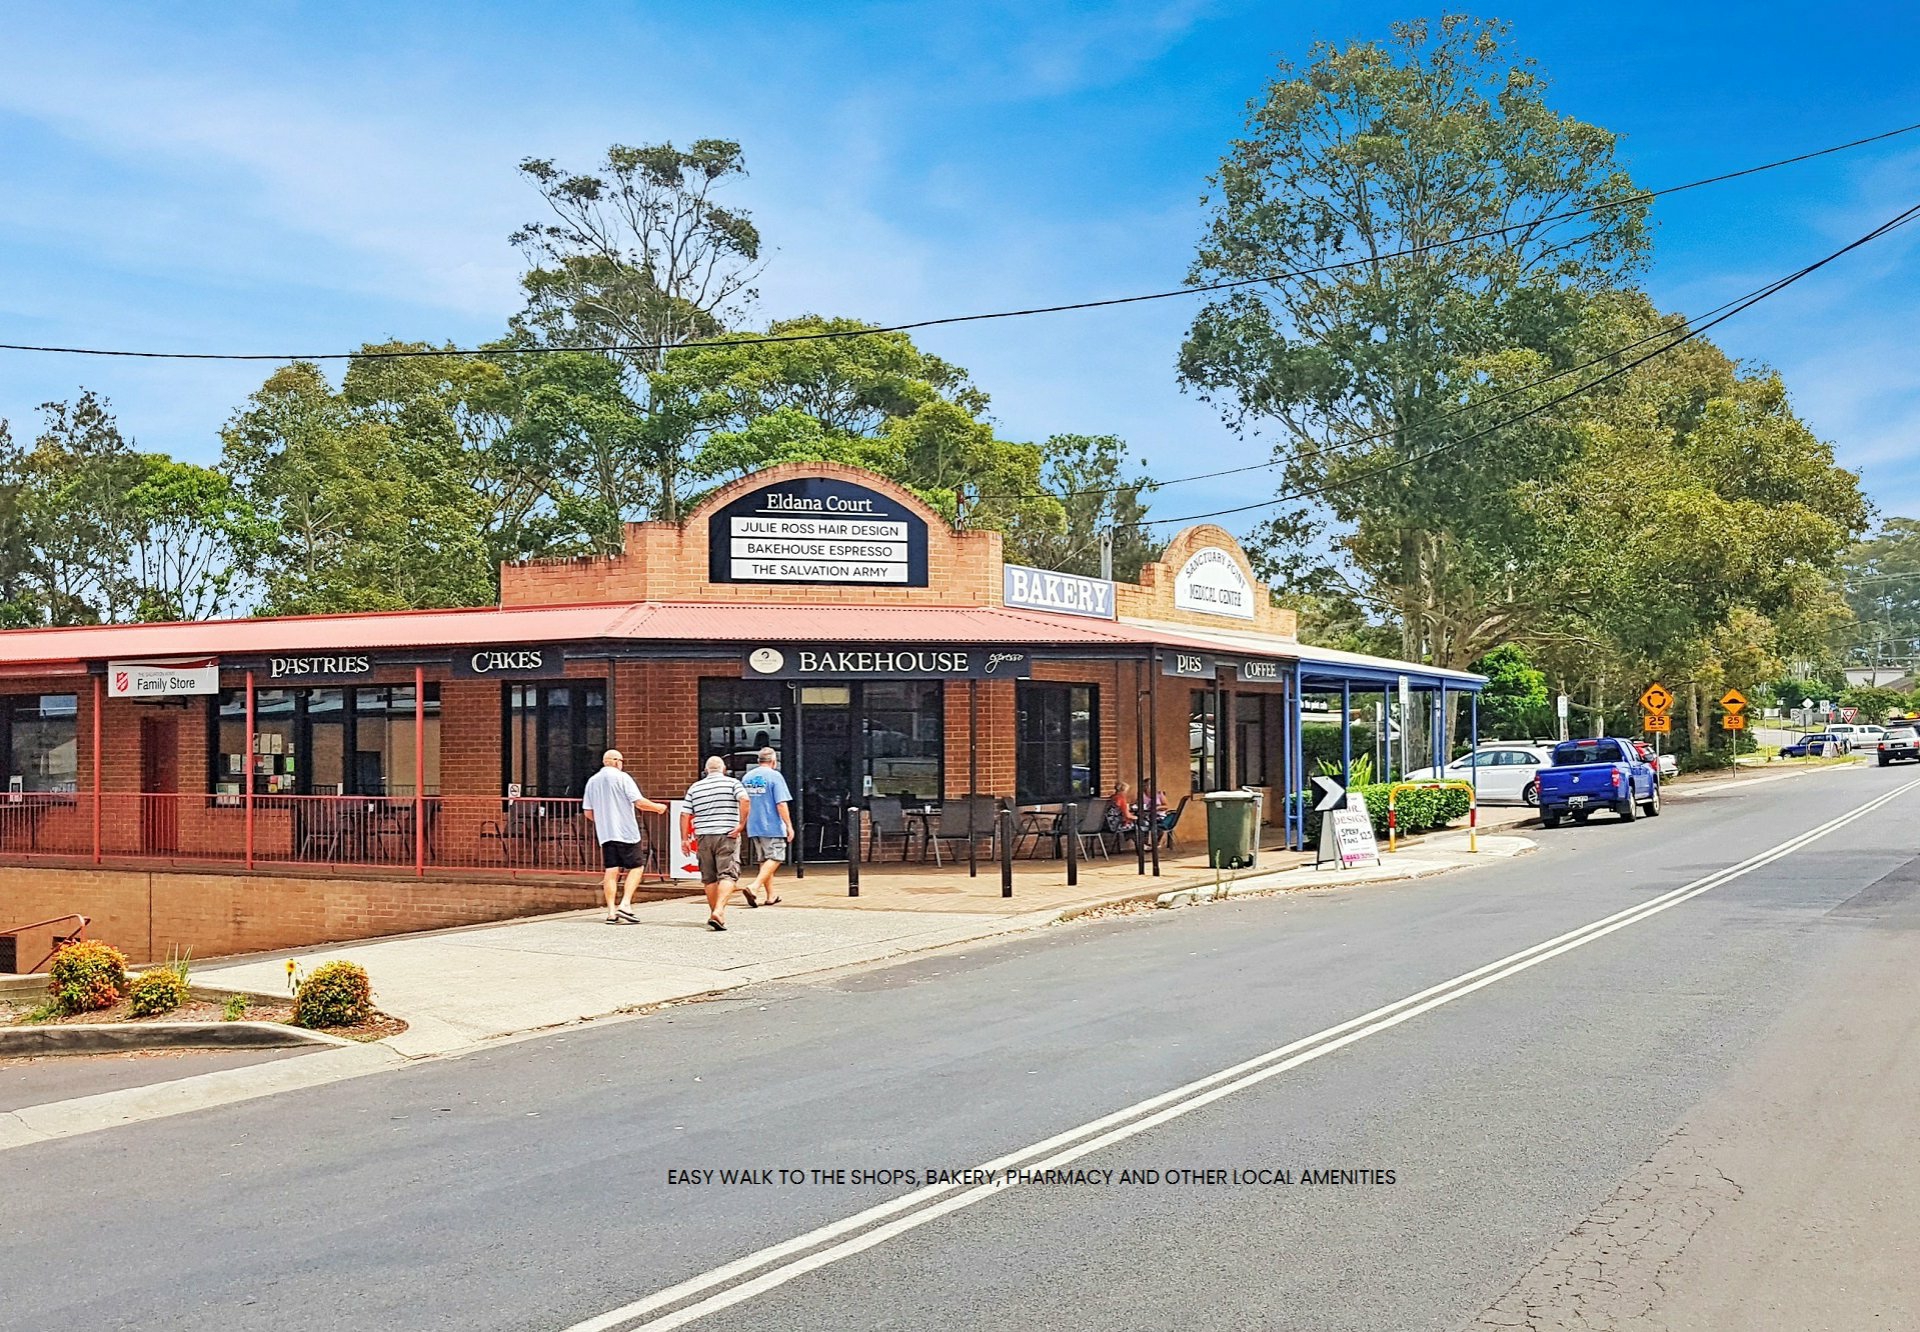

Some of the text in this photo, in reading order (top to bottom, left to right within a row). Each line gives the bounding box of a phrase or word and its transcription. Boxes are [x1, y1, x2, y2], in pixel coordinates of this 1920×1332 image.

[766, 493, 873, 512] Eldana Court
[741, 521, 899, 537] JULIE ROSS HAIR DESIGN
[747, 543, 893, 557] BAKEHOUSE ESPRESSO
[752, 564, 888, 578] THE SALVATION ARMY
[1010, 568, 1109, 614] BAKERY
[270, 656, 370, 678] PASTRIES
[471, 650, 543, 673] CAKES
[798, 651, 970, 672] BAKEHOUSE
[1176, 654, 1203, 674] PIES
[1244, 661, 1277, 679] COFFEE
[137, 677, 196, 692] Family Store
[1649, 716, 1665, 726] 25
[1727, 716, 1740, 725] 25
